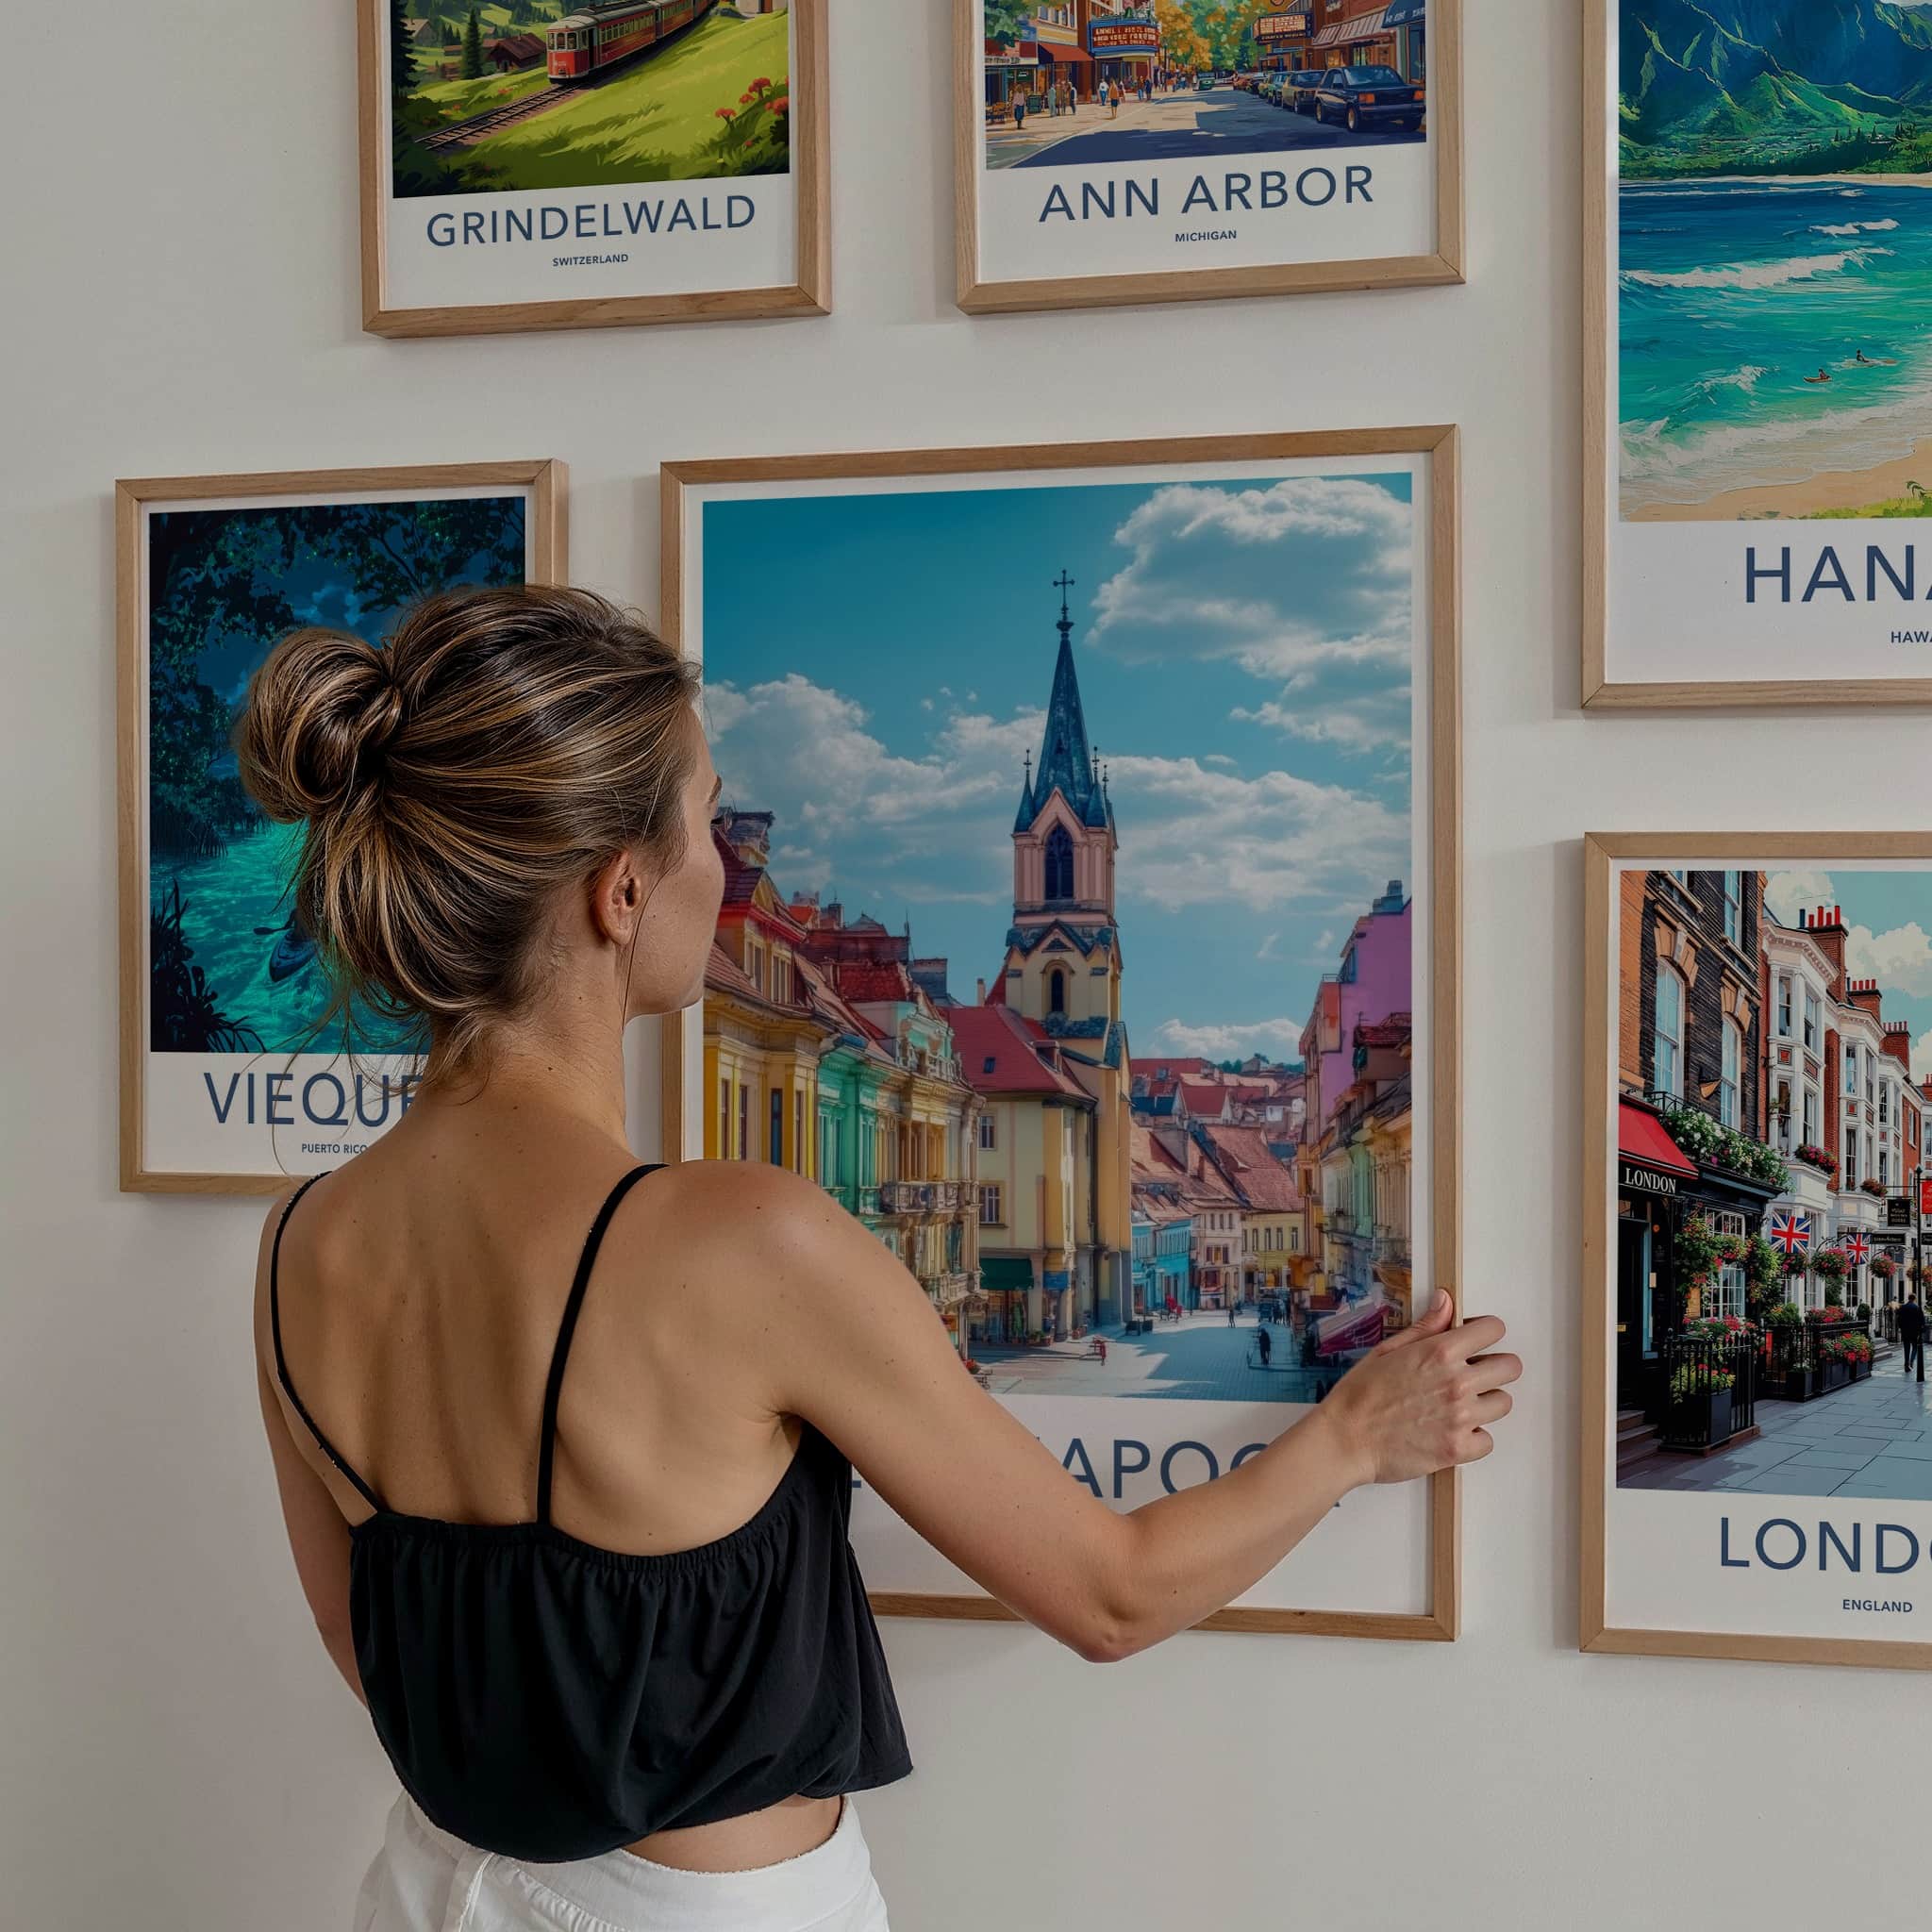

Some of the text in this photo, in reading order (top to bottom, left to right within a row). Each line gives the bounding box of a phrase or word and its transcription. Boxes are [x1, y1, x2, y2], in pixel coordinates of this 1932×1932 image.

[1039, 165, 1374, 223] ANN ARBOR
[427, 195, 755, 247] GRINDELWALD
[1174, 229, 1238, 242] MICHIGAN
[552, 254, 629, 267] SWITZERLAND
[1745, 544, 1932, 604] HAN
[301, 1143, 341, 1154] PUERTO
[1624, 1167, 1676, 1194] LONDON
[1721, 1517, 1932, 1574] LOND
[1842, 1599, 1913, 1613] ENGLAND
